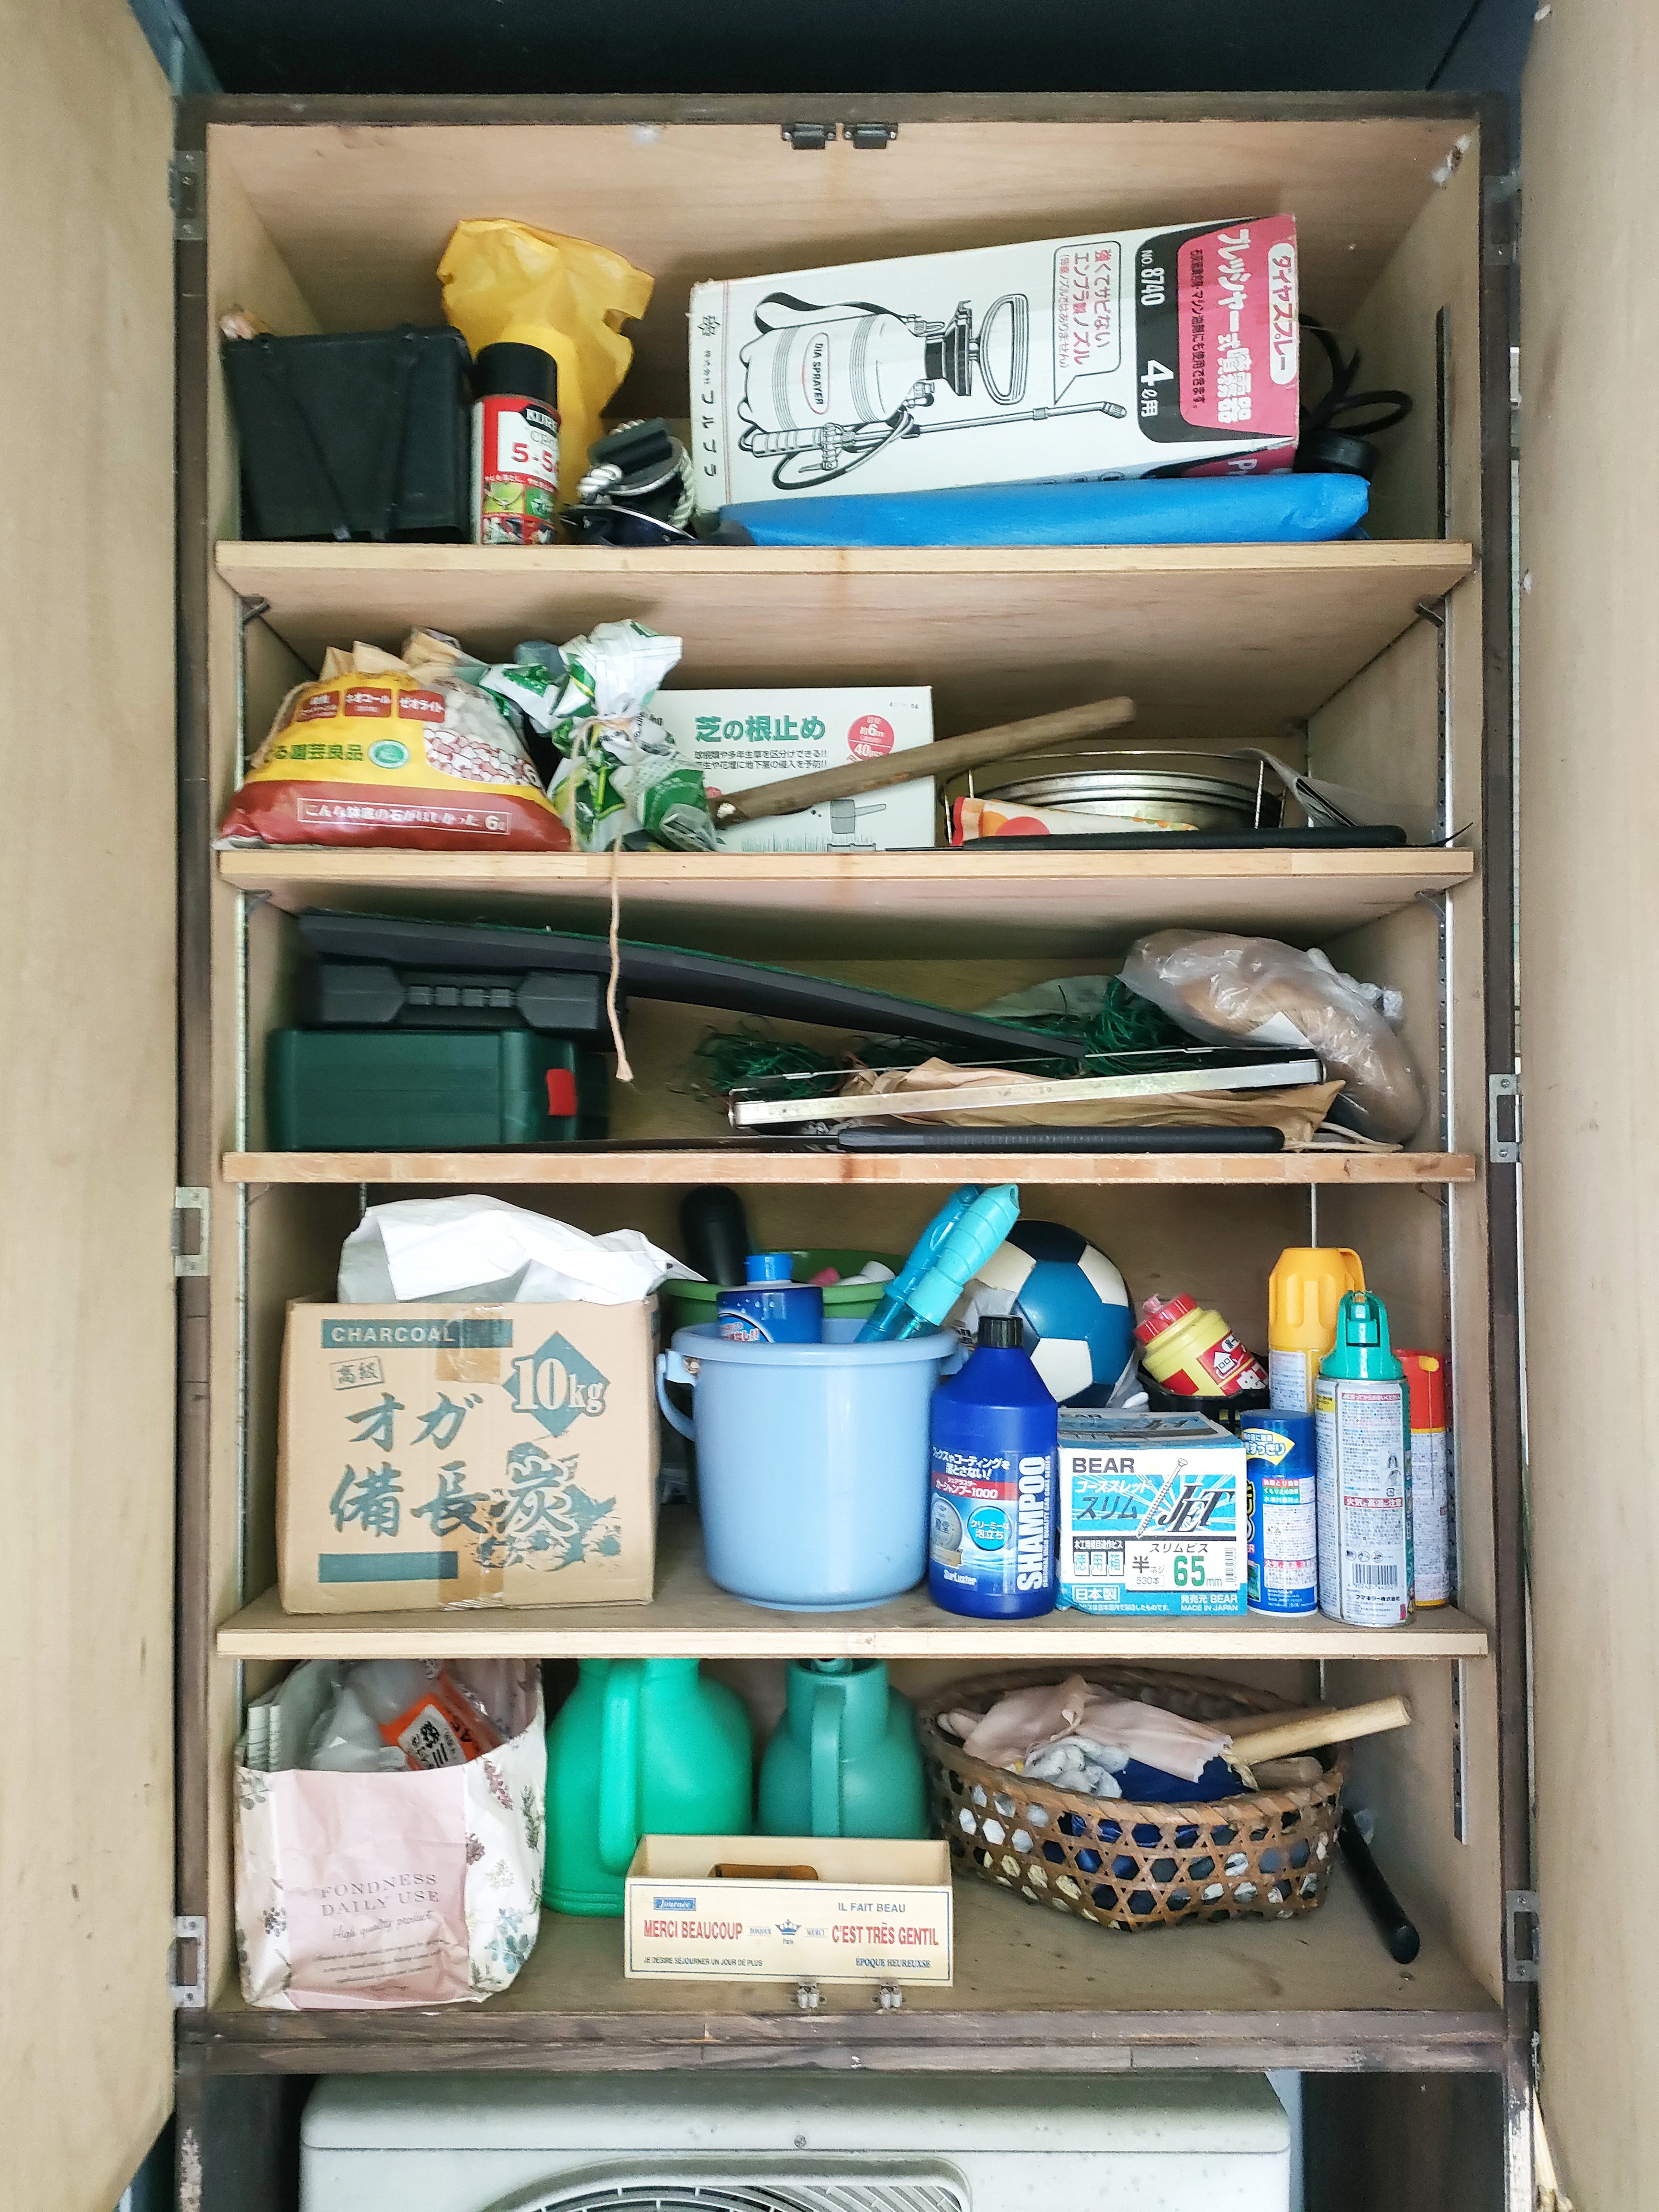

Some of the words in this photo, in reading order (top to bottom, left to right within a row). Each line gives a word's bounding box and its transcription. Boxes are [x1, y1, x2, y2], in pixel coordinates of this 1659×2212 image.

[1272, 255, 1294, 372] ダイヤスプレー
[813, 343, 822, 361] DIA
[812, 361, 824, 405] SPRAYER
[695, 715, 826, 742] 芝の根止め
[331, 1326, 456, 1342] CHARCOAL
[333, 1362, 379, 1385] 高級
[513, 1358, 604, 1414] 10kg
[346, 1392, 483, 1452] オガ
[1072, 1457, 1135, 1473] BEAR
[328, 1457, 578, 1538] 備長炭
[1076, 1496, 1138, 1520] スリム
[1157, 1484, 1236, 1533] JET
[974, 1528, 1004, 1540] 泡立ち
[1016, 1456, 1046, 1592] SHAMPOO
[1150, 1543, 1209, 1553] スリムビス
[1074, 1553, 1121, 1571] 徳用箱
[1173, 1555, 1223, 1587] 65mm
[943, 1569, 977, 1586] SurLuster
[1136, 1577, 1160, 1585] 530本
[1075, 1587, 1118, 1601] 日本製
[1180, 1594, 1207, 1604] 発売元
[1210, 1594, 1238, 1604] BEAR
[321, 1873, 438, 1899] FONDNESS
[321, 1896, 390, 1917] DAILY
[397, 1890, 440, 1904] USE
[838, 1902, 848, 1912] IL
[851, 1902, 874, 1913] FAIT
[876, 1903, 906, 1913] BEAU
[332, 1924, 356, 1941] High
[359, 1918, 393, 1938] quality
[643, 1919, 678, 1938] MERCI
[681, 1920, 742, 1940] BEAUCOUP
[832, 1924, 864, 1944] C'EST
[866, 1922, 895, 1945] TRÈS
[898, 1926, 939, 1946] GENTIL
